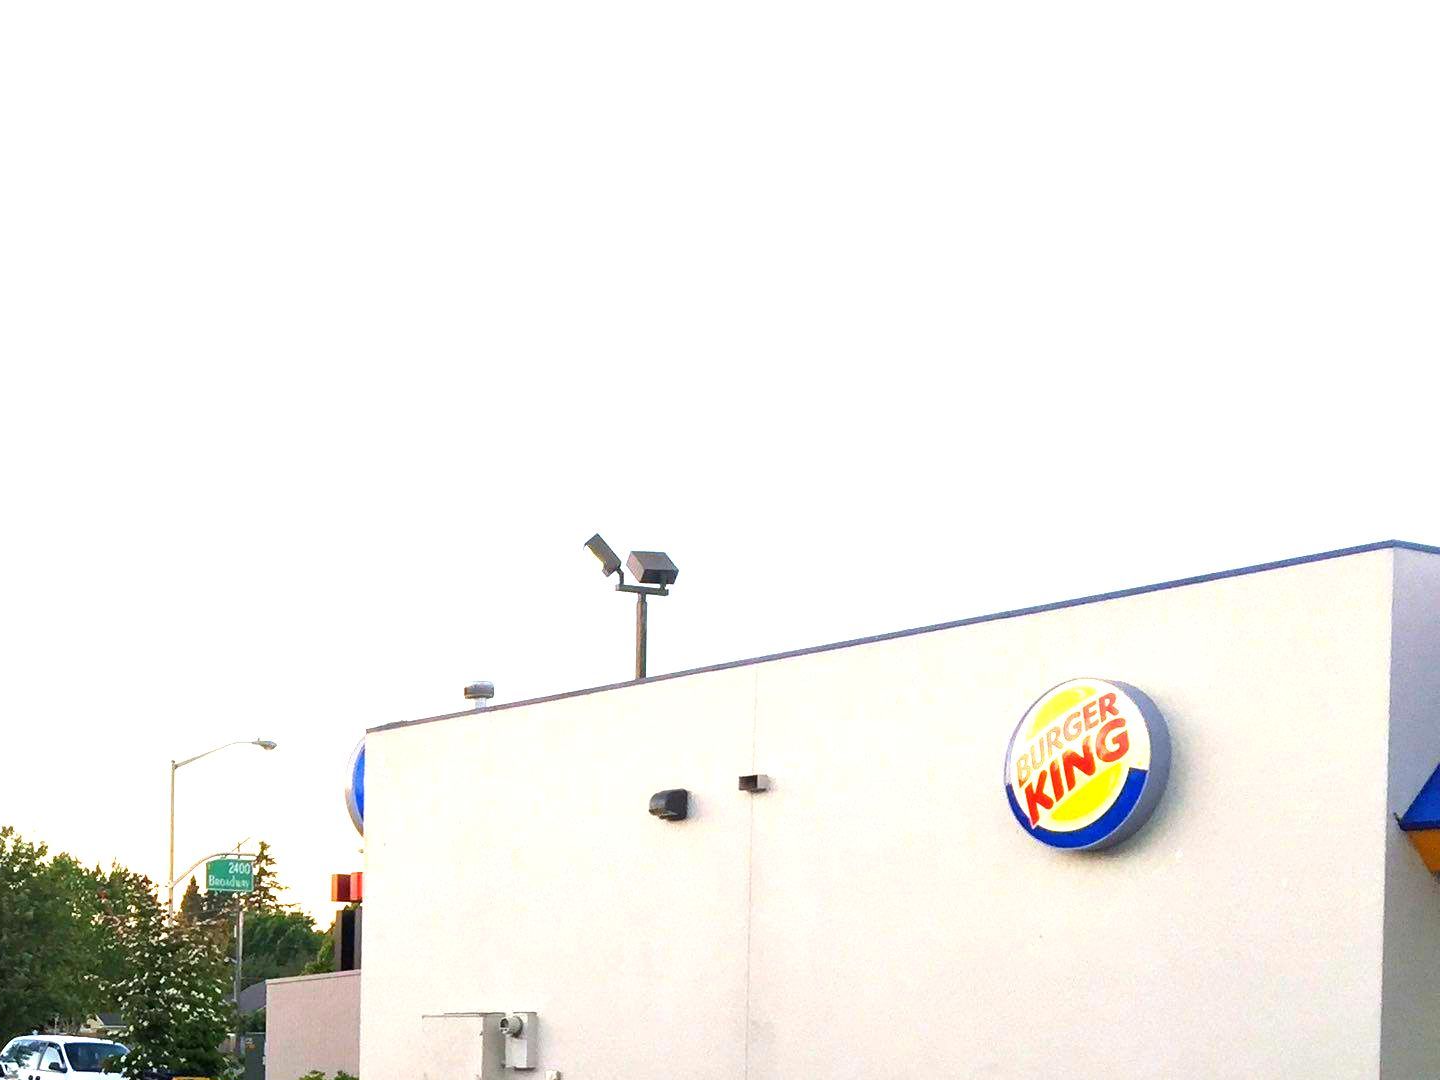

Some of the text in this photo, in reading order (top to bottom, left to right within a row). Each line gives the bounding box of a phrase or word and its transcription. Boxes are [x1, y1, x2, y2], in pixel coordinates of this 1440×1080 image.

[1016, 692, 1120, 789] BURGER
[1024, 717, 1130, 826] KING
[228, 861, 251, 875] 2400
